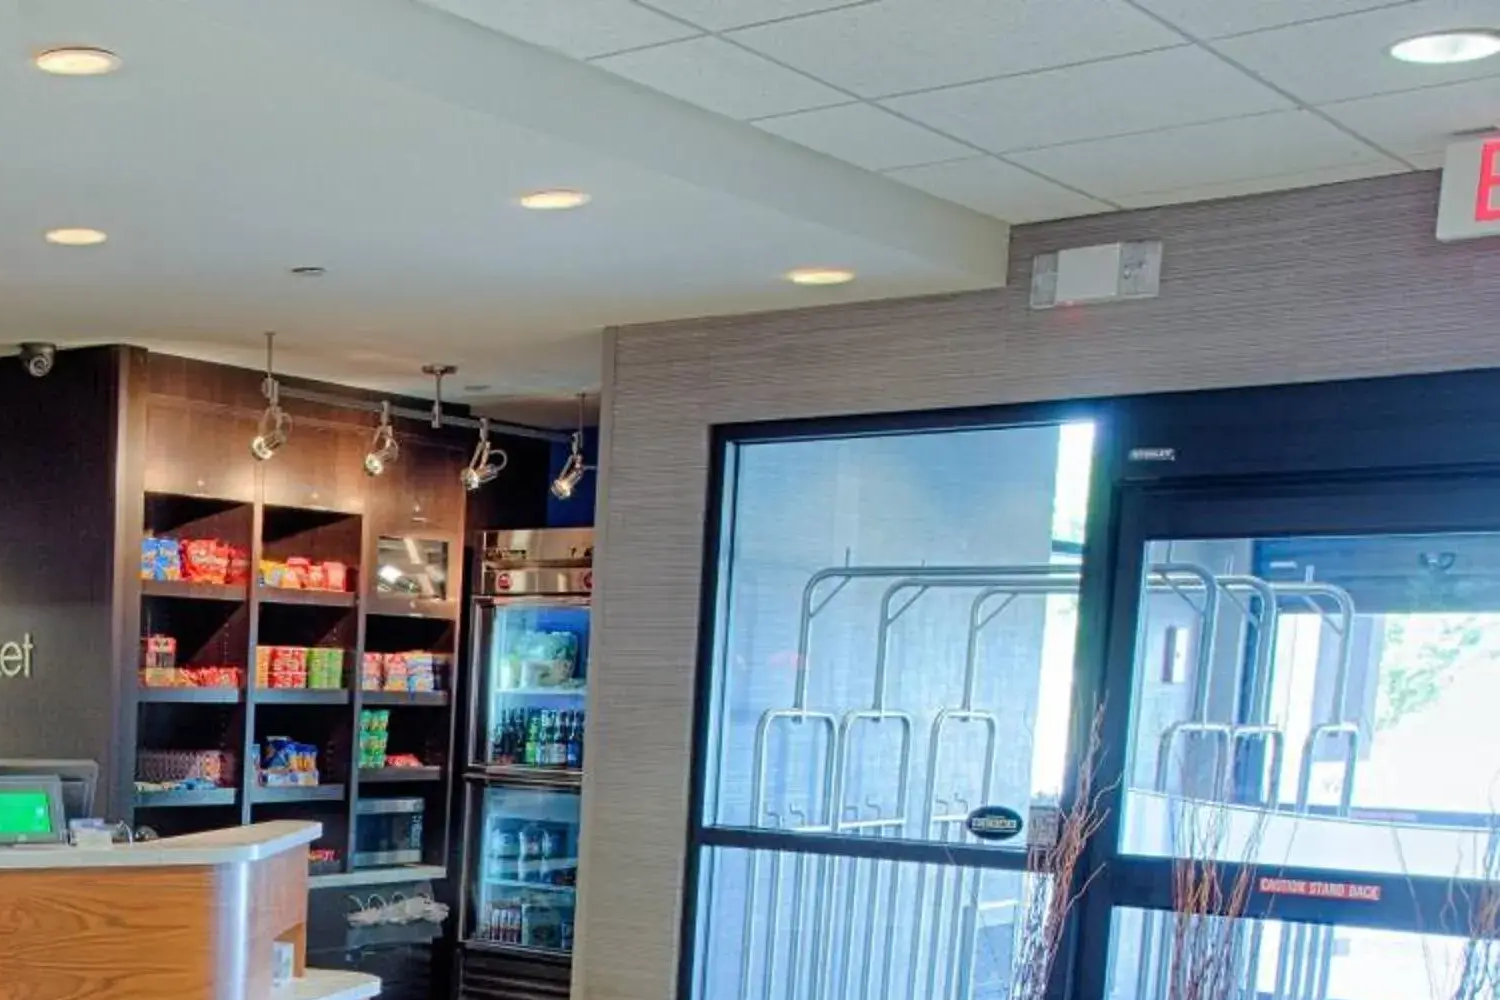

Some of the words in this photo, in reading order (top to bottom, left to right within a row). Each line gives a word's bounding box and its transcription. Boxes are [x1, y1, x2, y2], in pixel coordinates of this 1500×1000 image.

[1259, 877, 1306, 894] CAUTION
[1309, 881, 1344, 897] STAND
[1349, 884, 1380, 900] BACK
